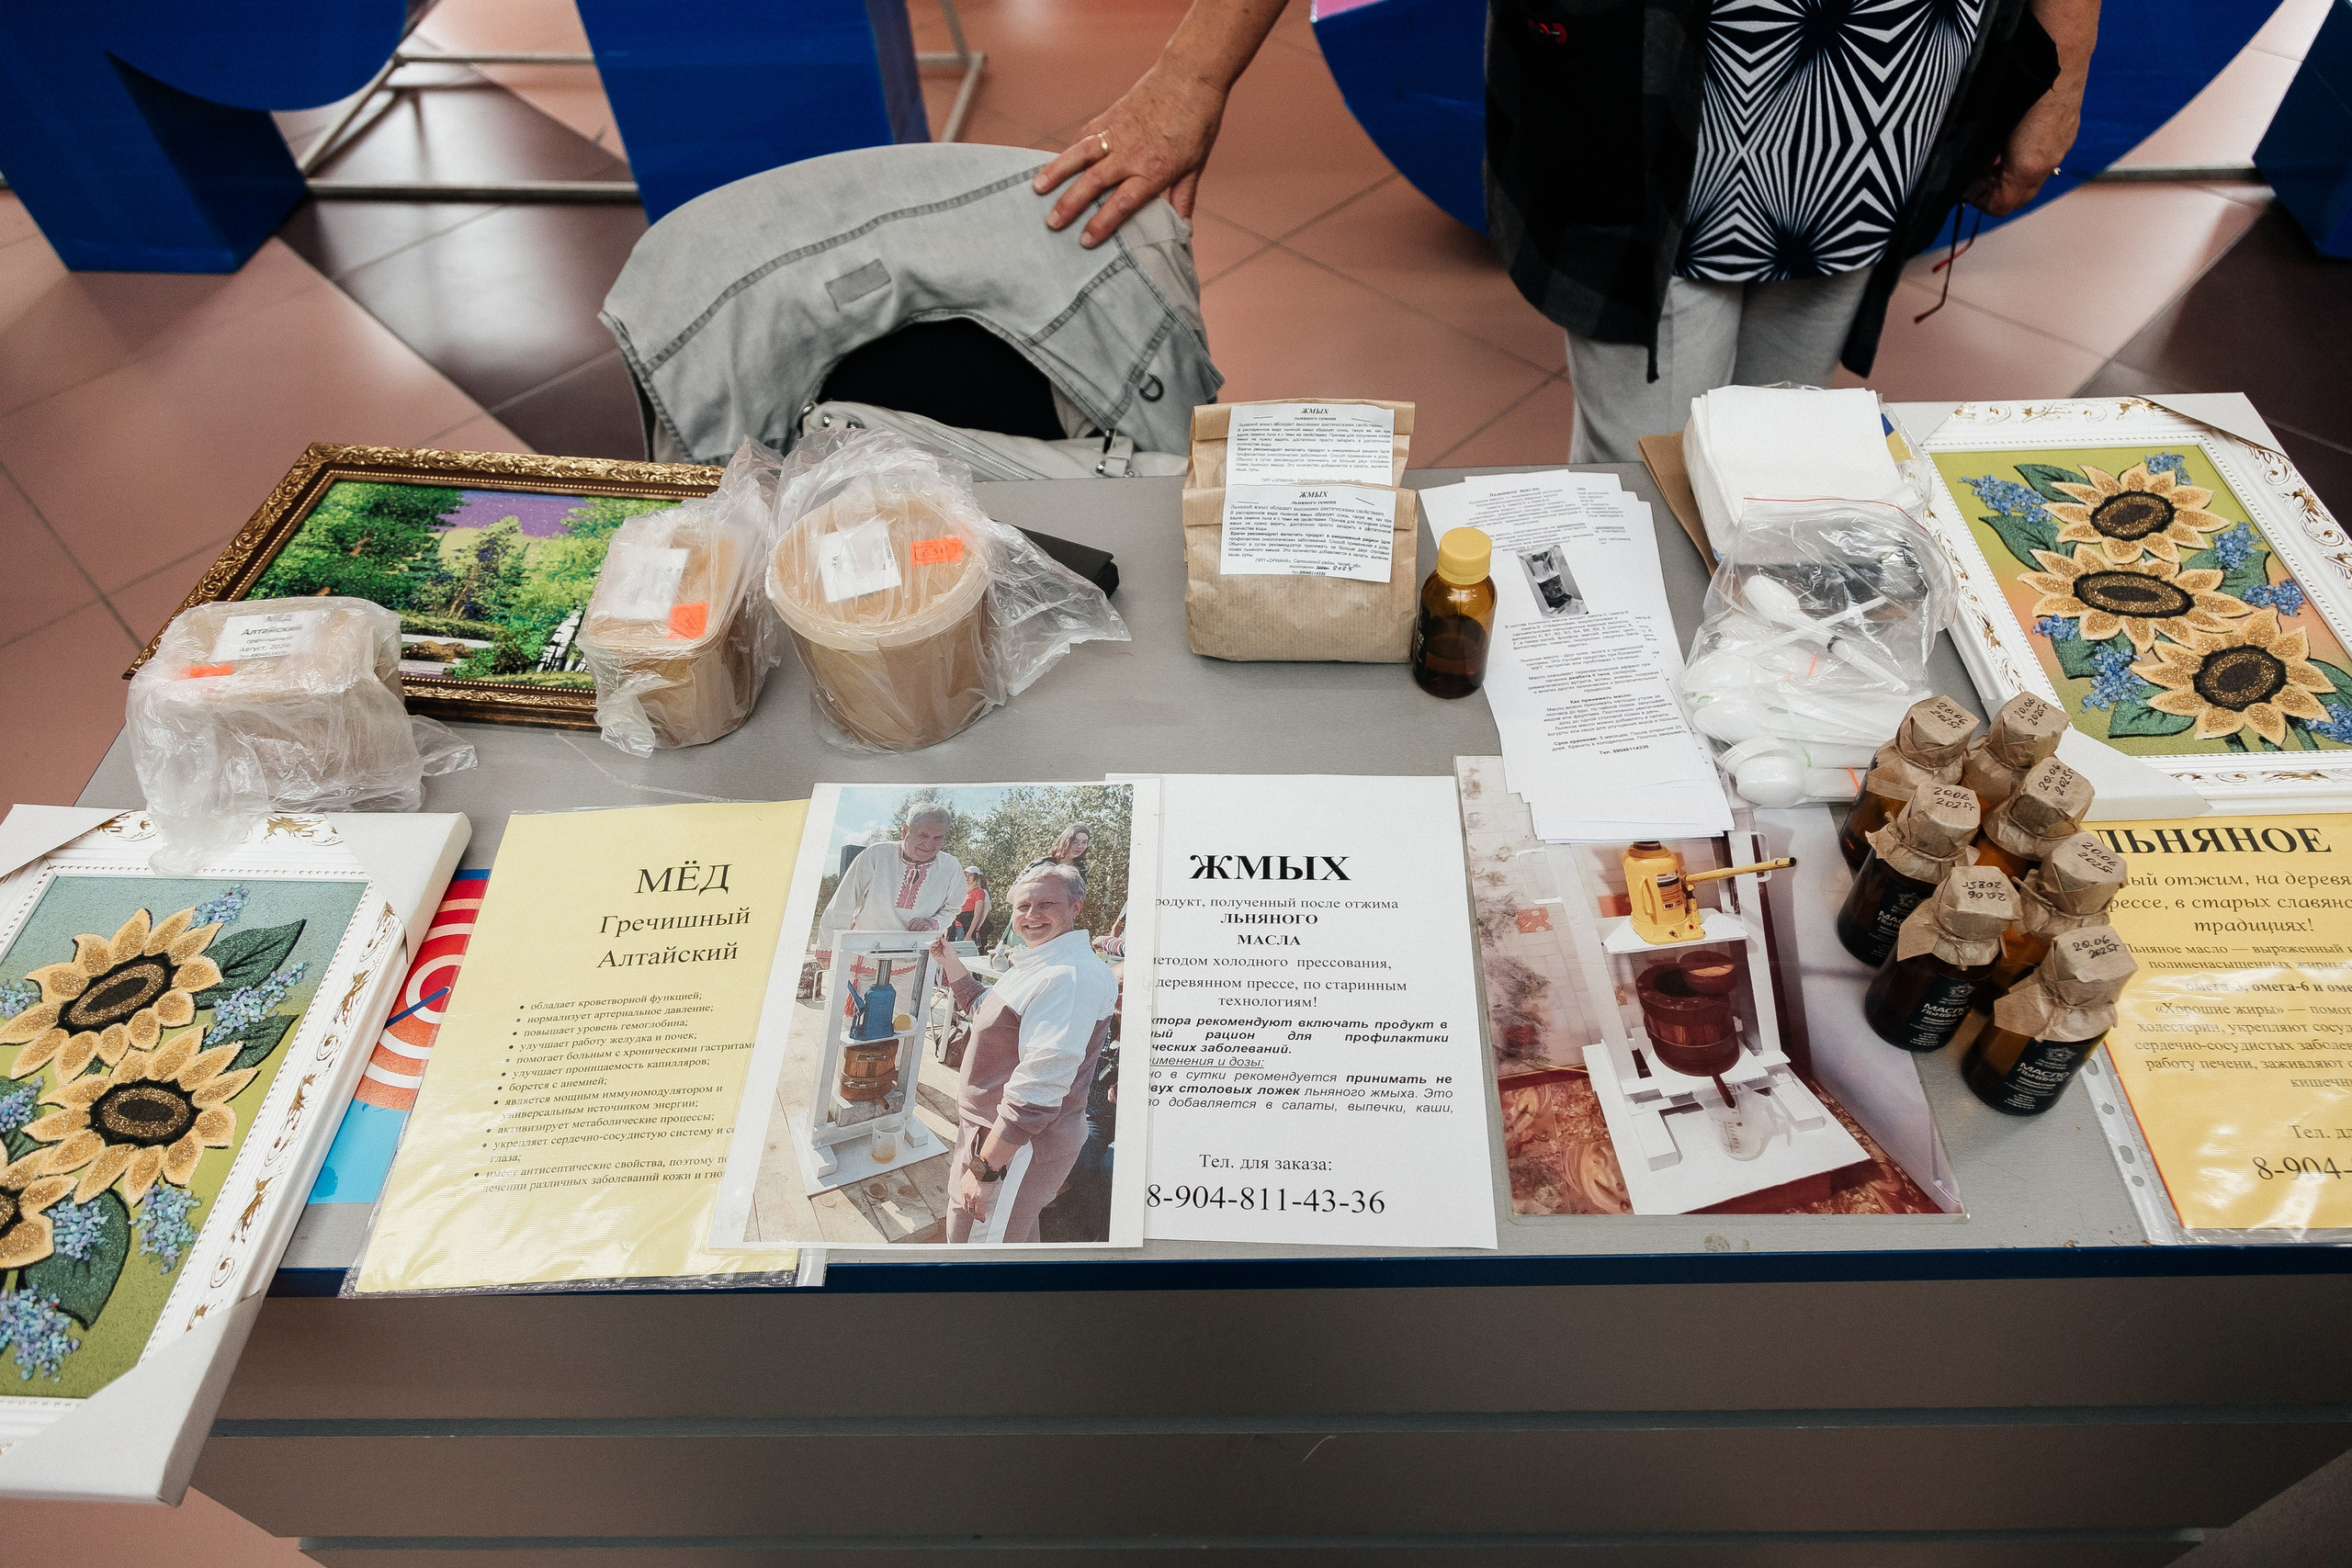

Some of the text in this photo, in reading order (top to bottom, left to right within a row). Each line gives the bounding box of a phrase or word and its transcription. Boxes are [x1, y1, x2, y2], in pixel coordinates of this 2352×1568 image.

[2093, 828, 2332, 853] ЛЬНЯНОЕ
[1188, 855, 1352, 881] ЖМЫХ
[634, 860, 732, 896] МЁД
[2126, 871, 2352, 889] ый отжим, на деревя
[1155, 898, 1399, 909] родукт, полученный после отжима
[2109, 898, 2168, 912] рессе,
[2192, 898, 2272, 912] старых
[2277, 898, 2352, 909] славянс
[598, 907, 751, 938] Гречишный
[1220, 913, 1318, 925] ЛЬНЯНОГО
[2193, 917, 2314, 935] традициях!
[1237, 934, 1301, 946] МАСЛА
[595, 942, 739, 969] Алтайский
[2251, 944, 2345, 956] выраженный
[1153, 957, 1392, 971] етодом холодного прессования,
[1155, 979, 1407, 993] деревянном прессе, по старинным
[2251, 981, 2310, 992] омега-6
[530, 992, 702, 1010] обладает кроветворной функцией;
[1218, 996, 1317, 1007] технологиям!
[527, 1005, 714, 1025] нормализует артериальное давление;
[1151, 1017, 1192, 1027] ктора
[1196, 1016, 1292, 1029] рекомендуют
[1298, 1020, 1369, 1028] включать
[1374, 1019, 1434, 1031] продукт
[523, 1019, 688, 1037] повышает уровень гемоглобина;
[2226, 1024, 2308, 1035] укрепляют
[519, 1041, 570, 1052] улучшает
[571, 1037, 607, 1049] работу
[609, 1036, 652, 1045] желудка
[664, 1033, 697, 1041] почек;
[1205, 1031, 1449, 1044] рацион для профилактики
[2134, 1039, 2352, 1053] сердечно-сосудистых заболев
[516, 1055, 564, 1064] помогает
[566, 1051, 612, 1060] больным
[623, 1046, 698, 1058] хроническими
[1152, 1043, 1292, 1054] ческих заболеваний.
[511, 1059, 710, 1080] улучшает проницаемость капилляров;
[1150, 1057, 1214, 1066] именения
[1229, 1056, 1265, 1067] дозы:
[2020, 1062, 2069, 1078] МАСЛО
[2144, 1057, 2344, 1072] работу печени, заживляют
[509, 1083, 550, 1093] борется
[560, 1076, 607, 1087] анемией;
[1186, 1071, 1226, 1082] сутки
[1234, 1071, 1337, 1084] рекомендуется
[1346, 1075, 1427, 1085] принимать
[504, 1096, 551, 1106] является
[553, 1093, 599, 1102] мощным
[602, 1086, 713, 1099] иммуномодулятором
[1149, 1083, 1453, 1098] вух столовых ложек льняного жмыха. Это
[501, 1101, 698, 1121] универсальным источником энергии;
[1168, 1096, 1257, 1109] добавляется
[1282, 1102, 1337, 1112] салаты,
[1347, 1103, 1406, 1114] выпечки,
[1416, 1104, 1453, 1114] каши,
[497, 1114, 714, 1134] активизирует метаболические процессы;
[493, 1139, 549, 1151] укрепляет
[551, 1131, 667, 1146] сердечно-сосудистую
[670, 1128, 714, 1138] систему
[490, 1155, 521, 1163] глаза;
[520, 1162, 612, 1176] антисептические
[615, 1159, 666, 1169] свойства,
[669, 1157, 715, 1166] поэтому
[1199, 1154, 1332, 1171] Тел. для заказа:
[2253, 1156, 2352, 1180] 8-904-
[528, 1178, 588, 1192] различных
[590, 1172, 660, 1185] заболеваний
[704, 1169, 724, 1179] гно
[1146, 1184, 1385, 1214] 8-904-811-43-36
